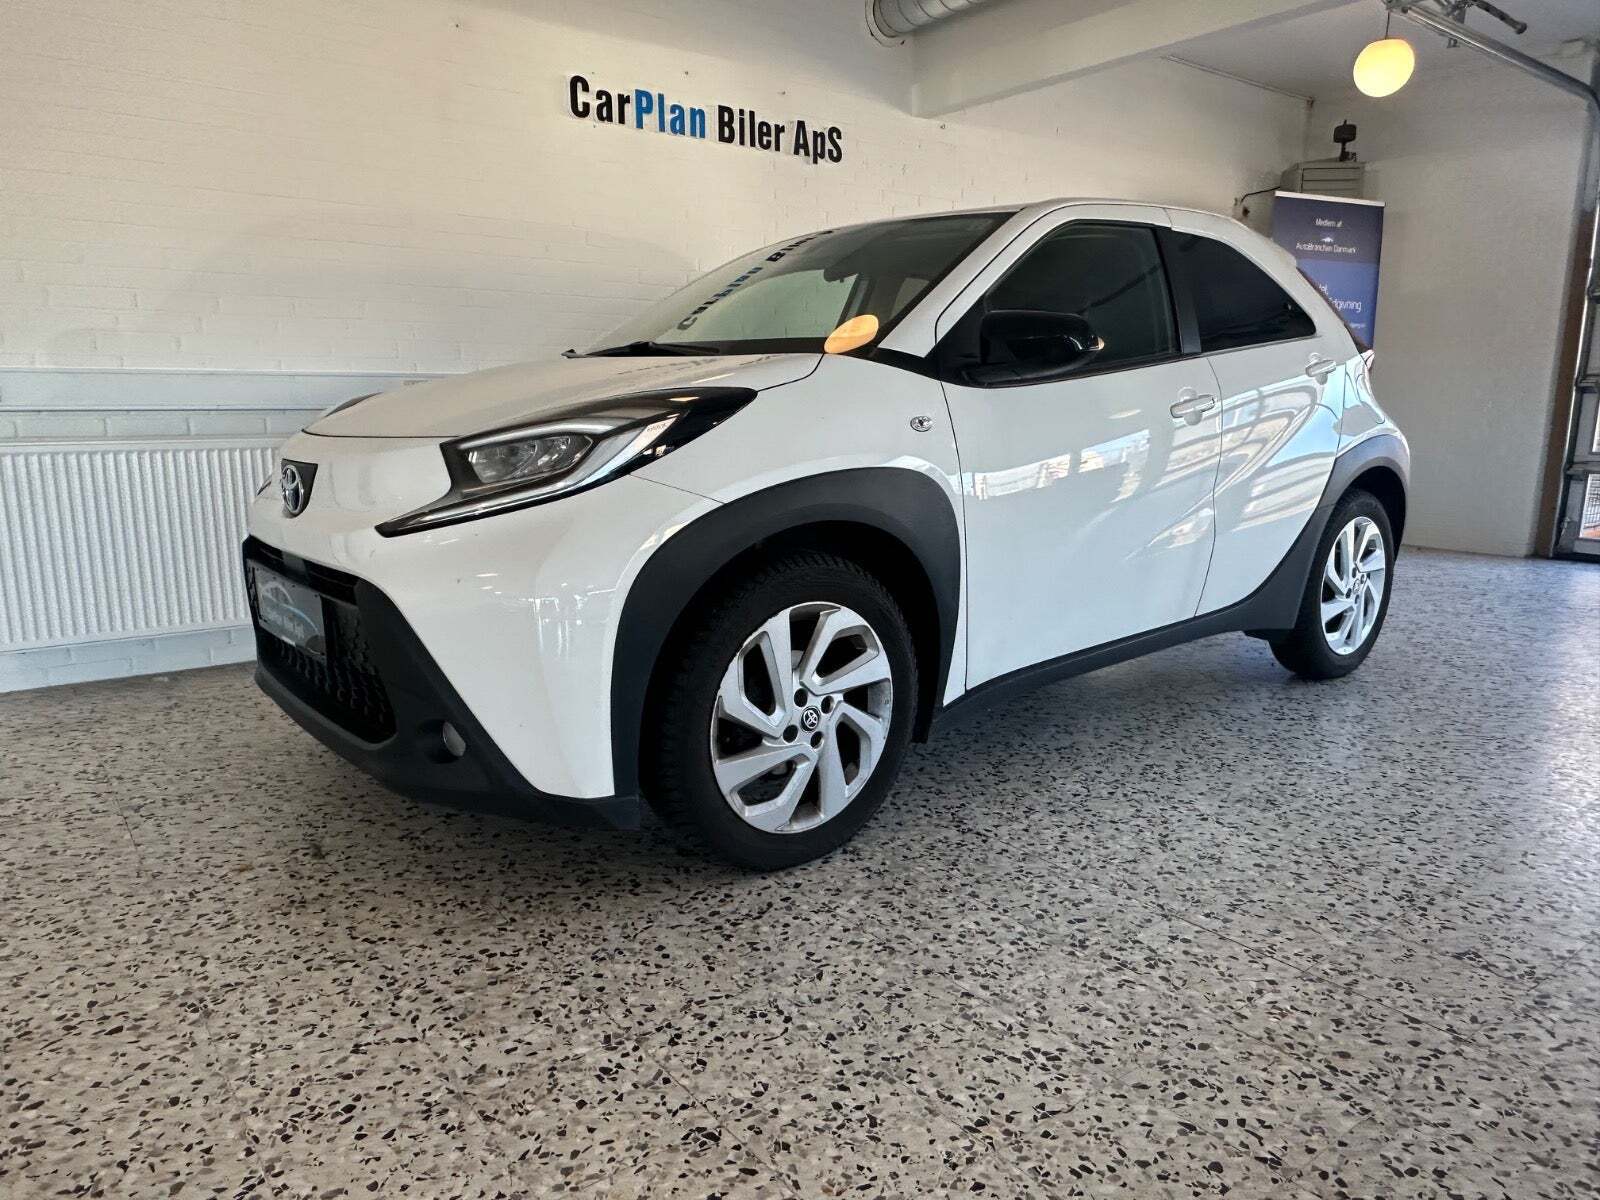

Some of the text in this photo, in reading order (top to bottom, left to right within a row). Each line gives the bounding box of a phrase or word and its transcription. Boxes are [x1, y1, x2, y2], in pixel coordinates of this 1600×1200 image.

[569, 75, 842, 164] CarPlan Biler ApS
